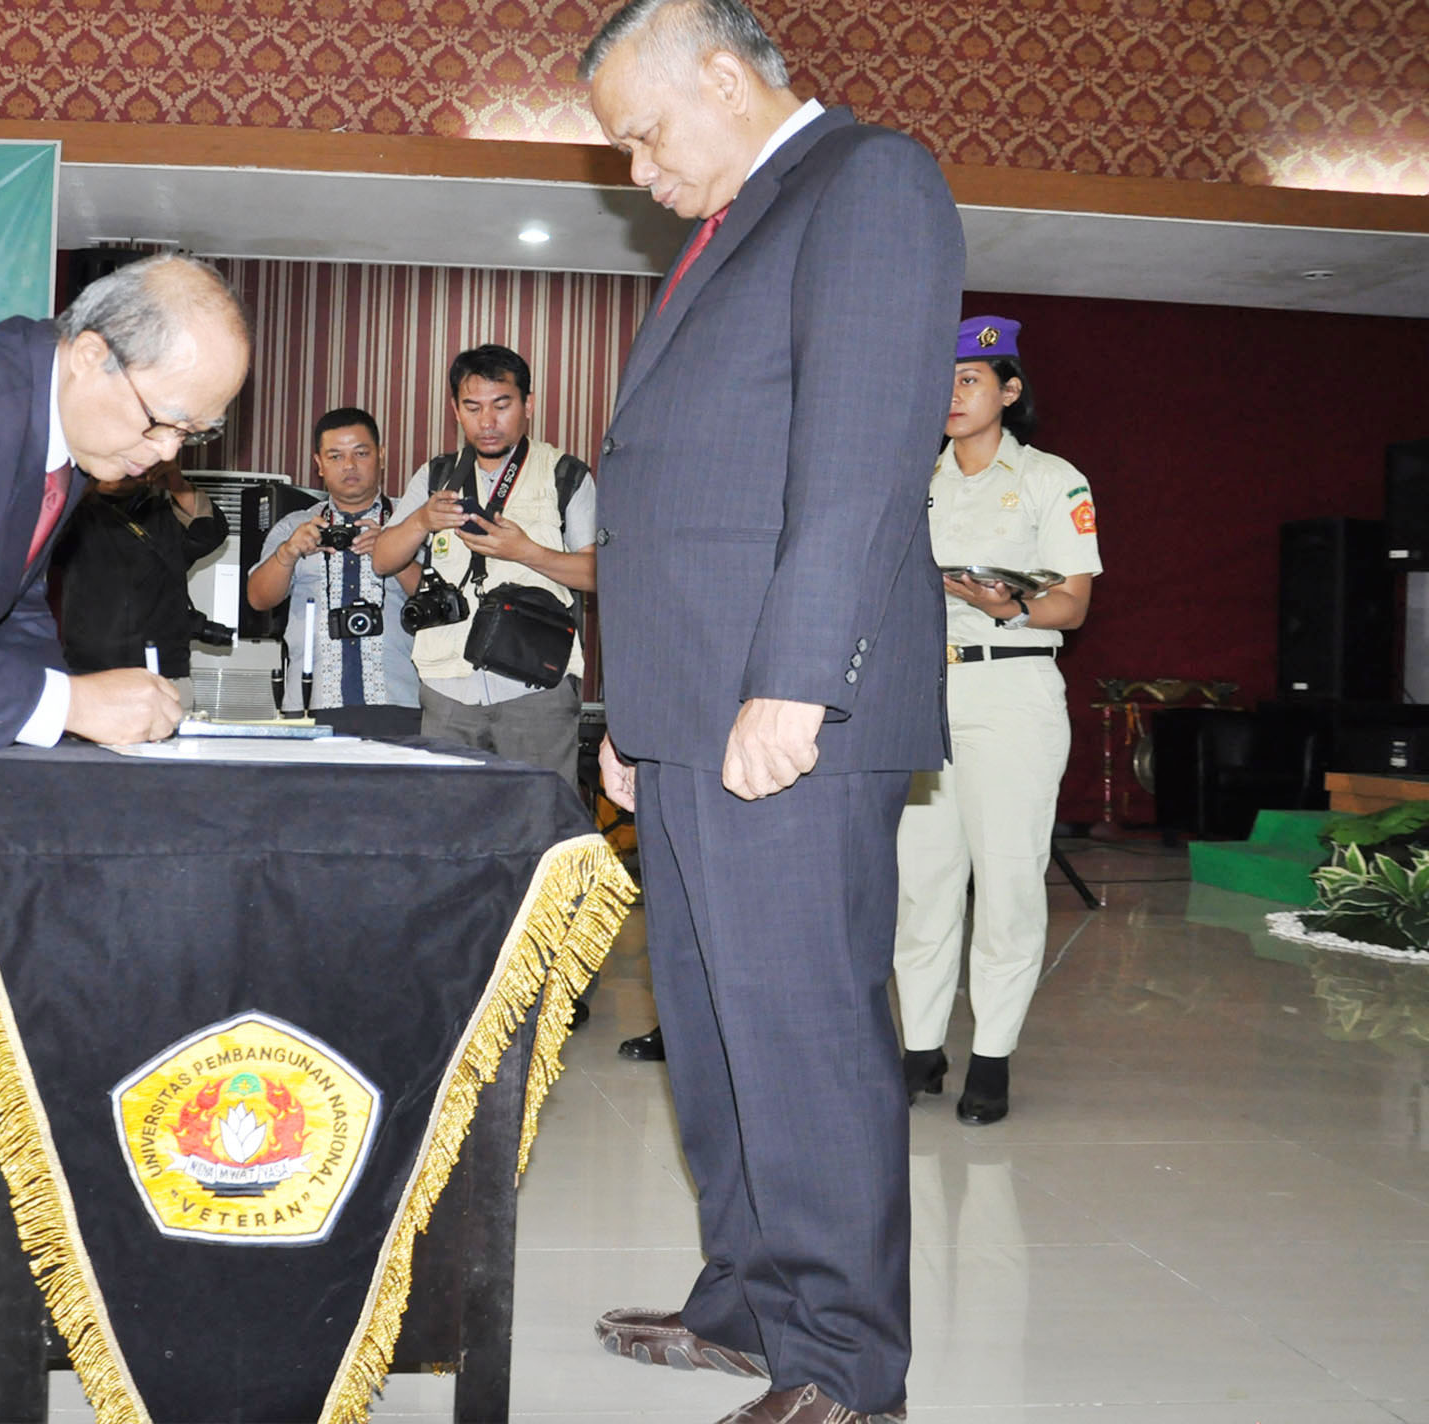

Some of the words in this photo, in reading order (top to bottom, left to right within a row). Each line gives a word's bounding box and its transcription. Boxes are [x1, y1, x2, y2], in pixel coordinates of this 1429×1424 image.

[503, 462, 518, 484] EOS
[142, 1073, 192, 1178] UNIVERSITAS
[193, 1047, 332, 1093] PEMBANGUNAN
[309, 1094, 348, 1186] NASIONAL
[170, 1188, 311, 1228] "VETERAN"
